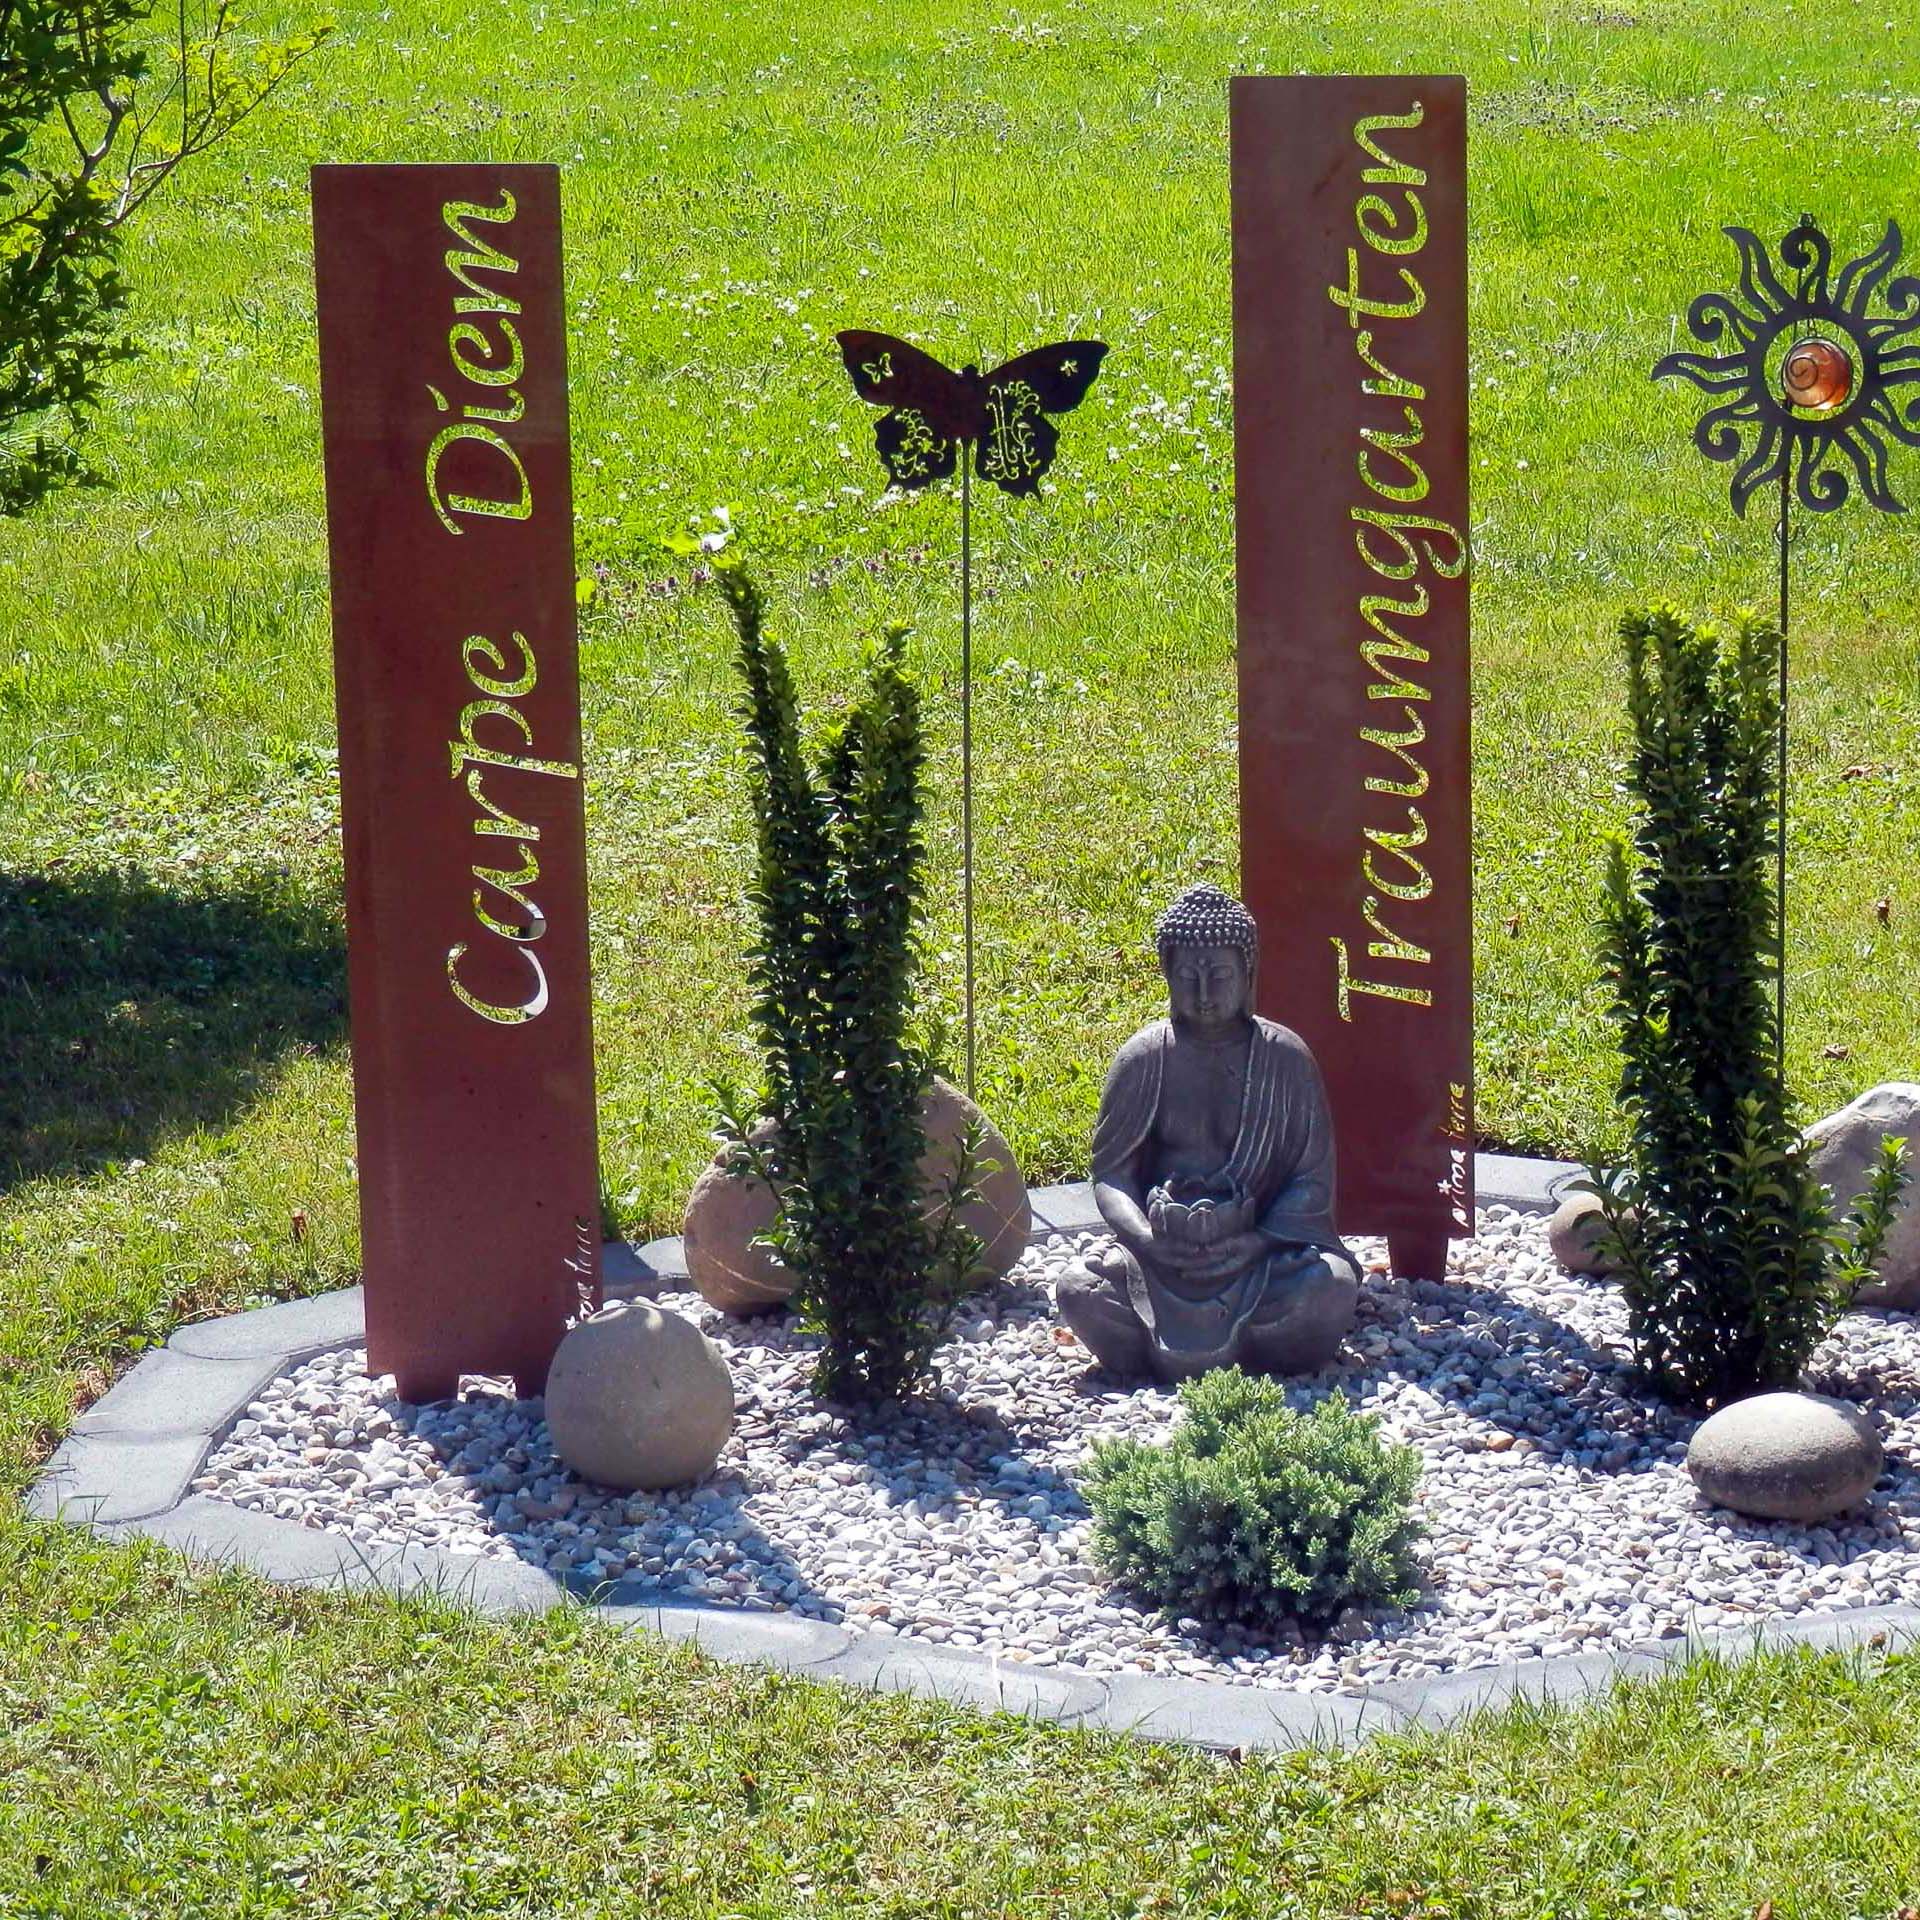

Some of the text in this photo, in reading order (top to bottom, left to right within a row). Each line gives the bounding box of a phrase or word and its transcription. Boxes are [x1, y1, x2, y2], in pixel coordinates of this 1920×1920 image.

[425, 187, 579, 1026] Carpe Diem
[1328, 99, 1468, 1023] Traumgarten
[1436, 1148, 1470, 1228] prima
